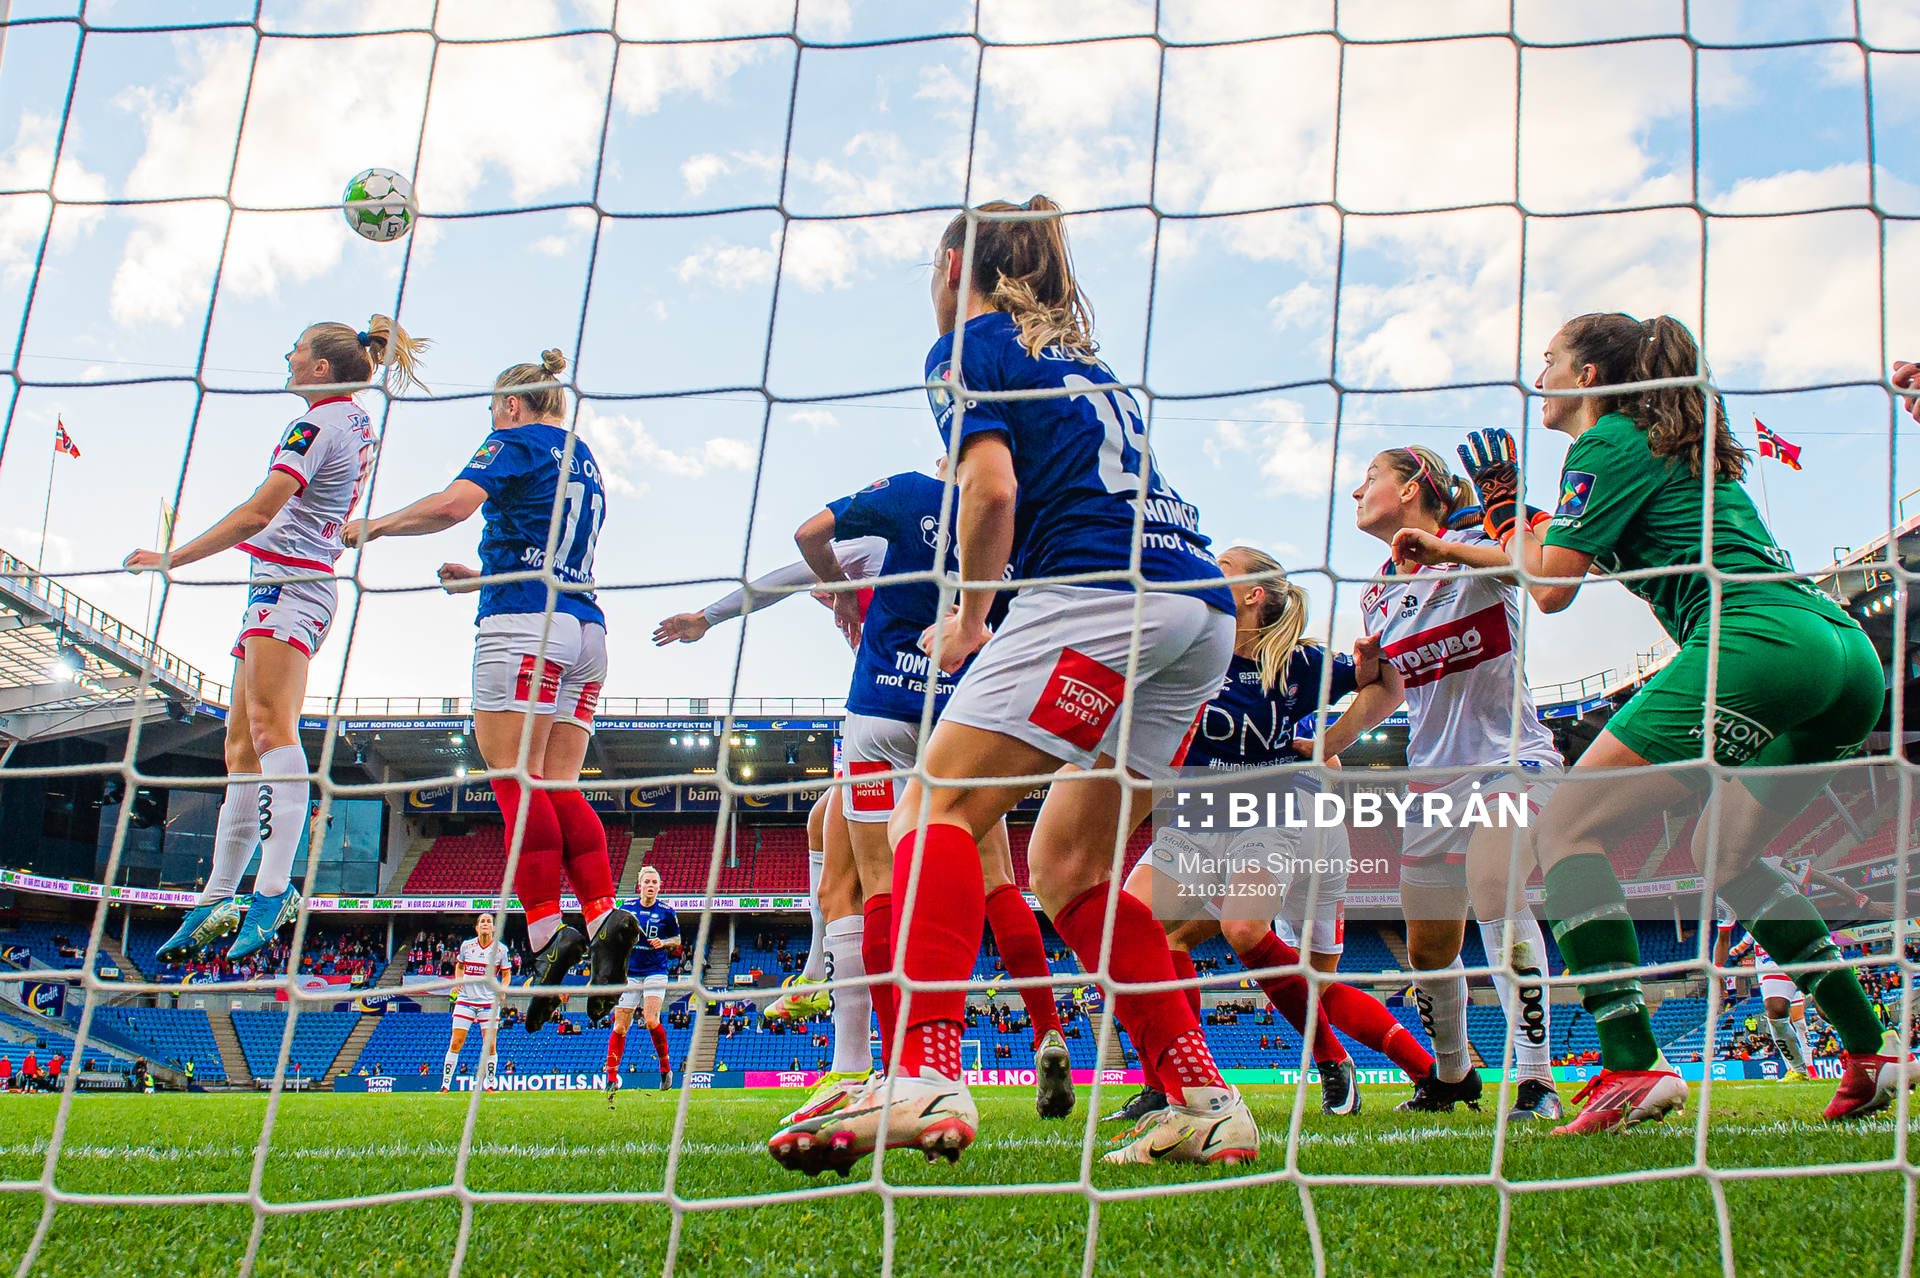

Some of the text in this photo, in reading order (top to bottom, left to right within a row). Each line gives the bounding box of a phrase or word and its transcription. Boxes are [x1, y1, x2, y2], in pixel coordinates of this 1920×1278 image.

[1142, 533, 1184, 551] mot
[876, 672, 957, 695] mot rassm
[1058, 675, 1115, 714] THON
[1055, 697, 1100, 727] HOTELS
[348, 721, 369, 729] SUNT
[370, 721, 412, 729] KOSTHOLD
[596, 721, 712, 729] OPPLEV BENDIT-EFFEKTEN
[1688, 726, 1751, 763] HTELS
[641, 784, 672, 801] Bendit
[857, 787, 886, 797] HOTELS
[364, 1076, 396, 1087] THON
[776, 1072, 808, 1082] THON
